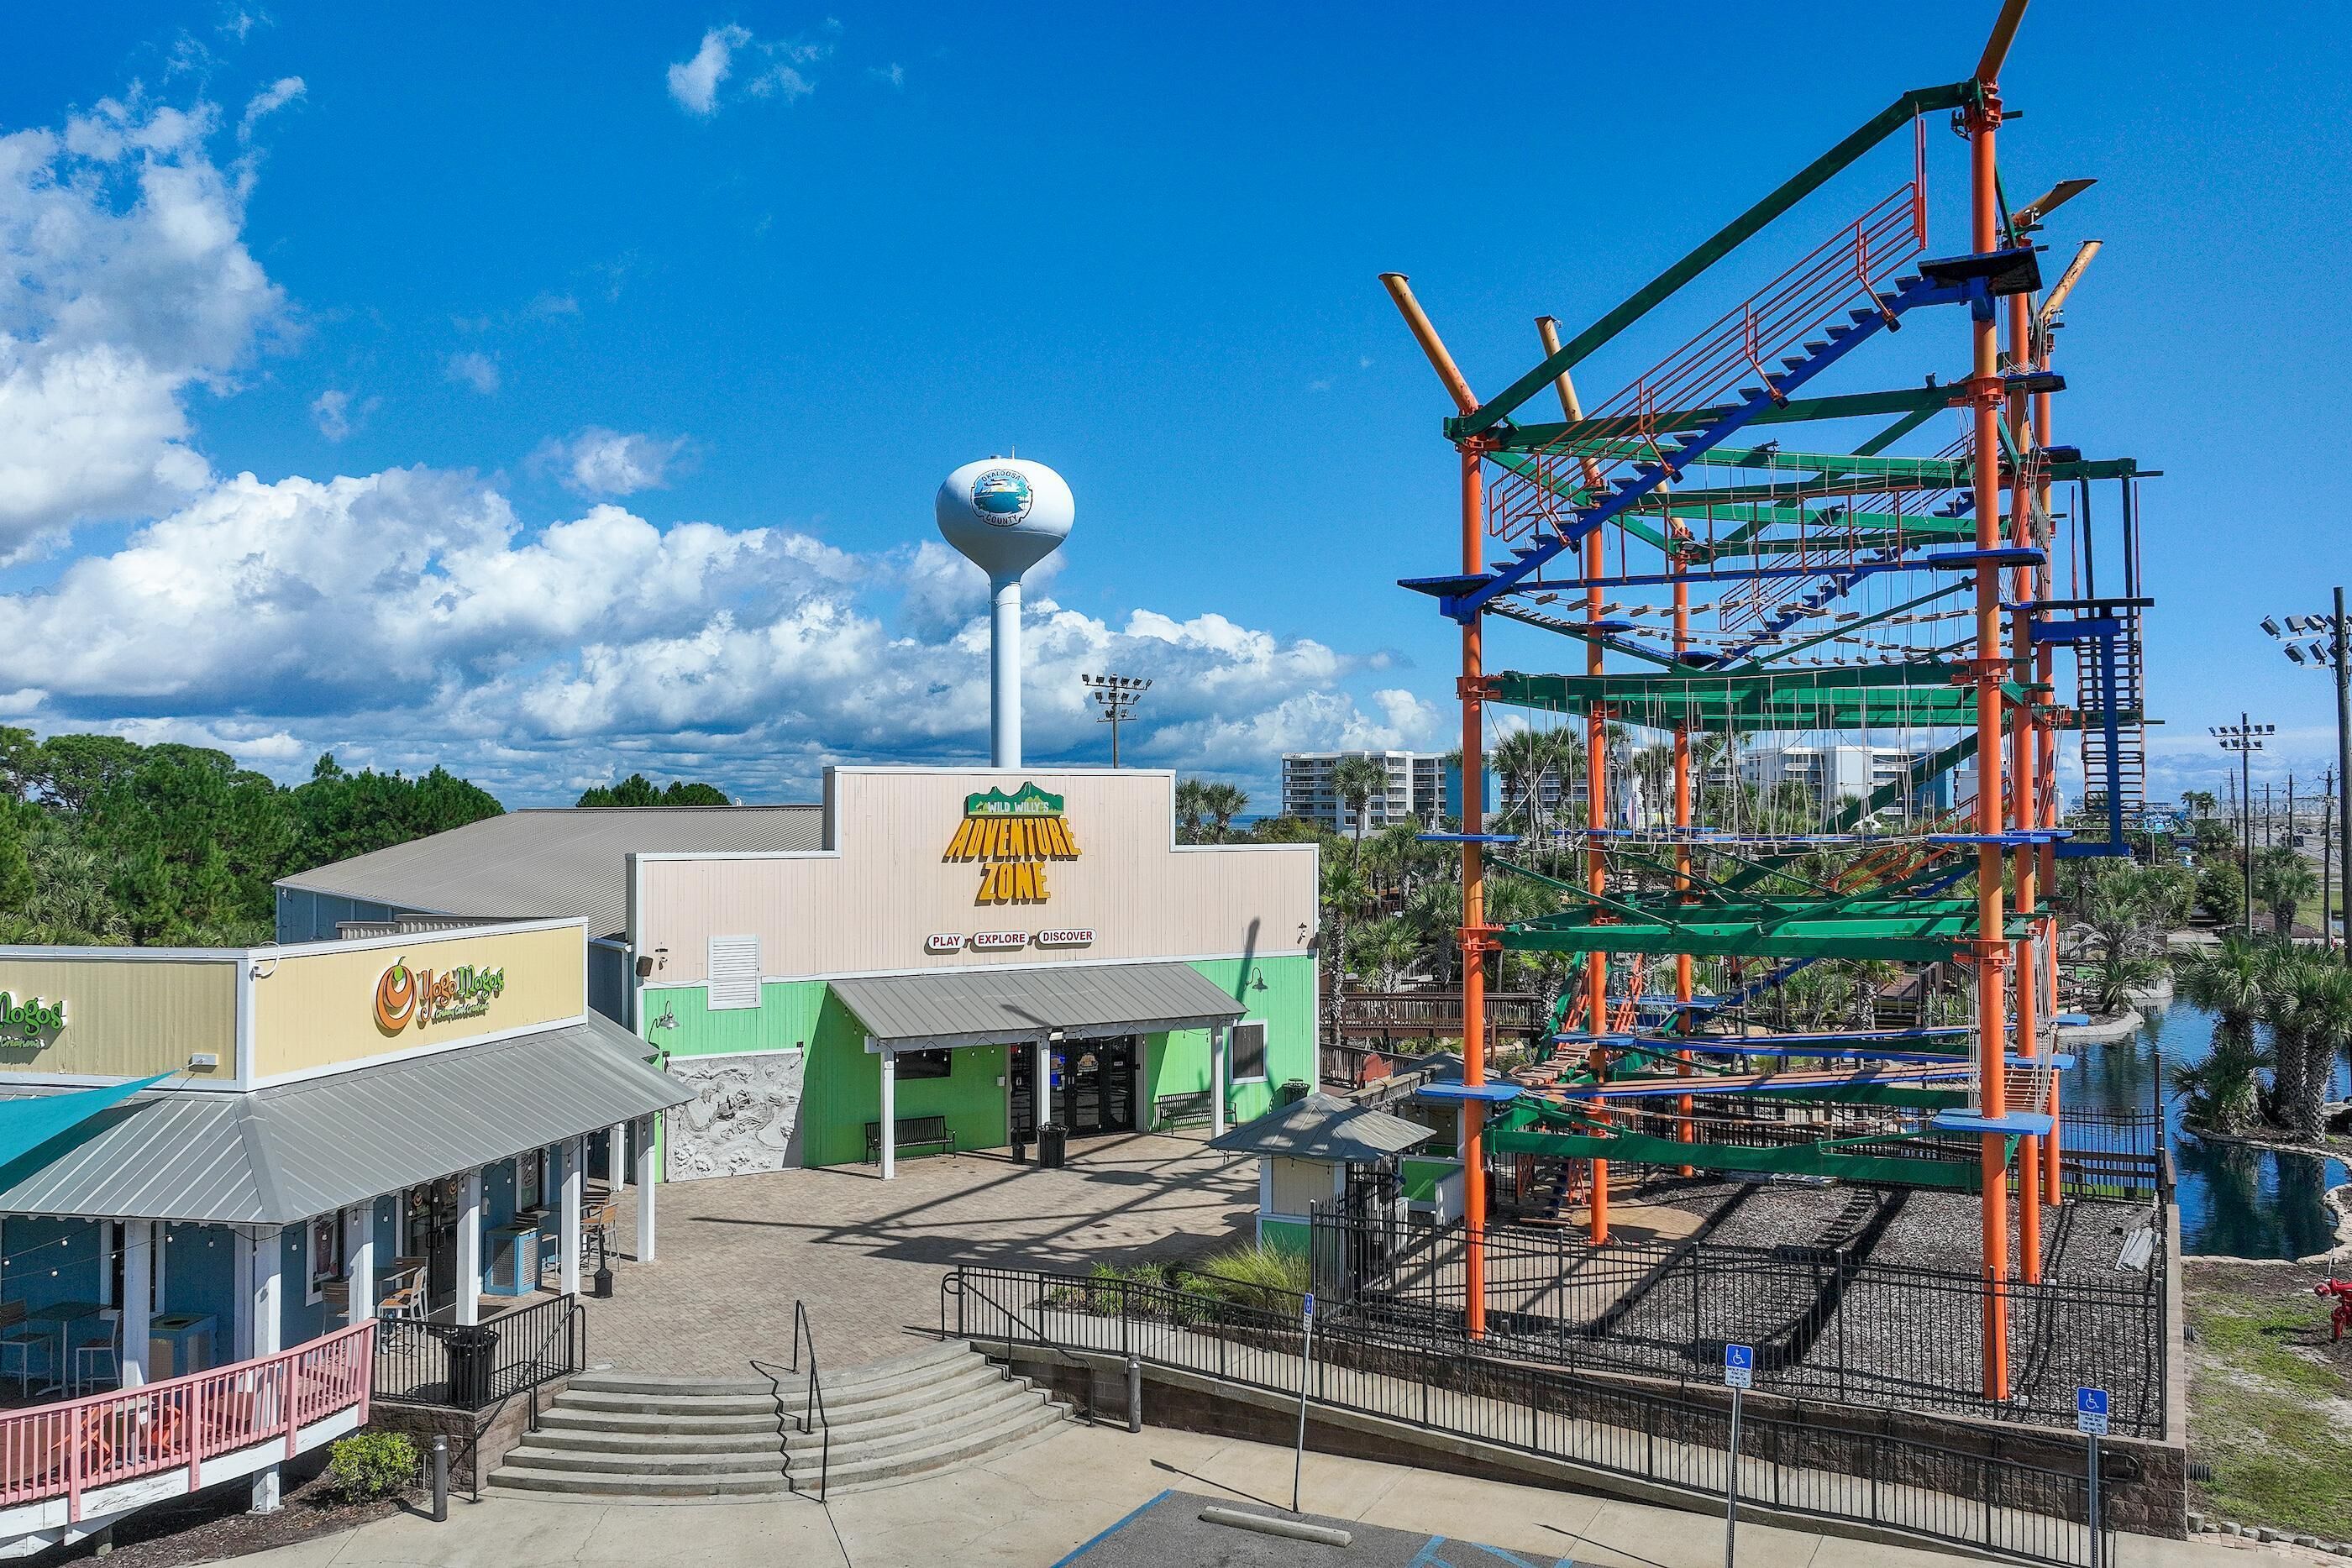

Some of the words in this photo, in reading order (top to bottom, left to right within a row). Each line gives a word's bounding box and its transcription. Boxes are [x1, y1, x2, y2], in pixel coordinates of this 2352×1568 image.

[981, 470, 1021, 482] OKALOOSA
[985, 514, 1017, 525] COUNTY
[987, 801, 1011, 813] WILD
[1014, 801, 1049, 813] WILLY'S
[944, 817, 1082, 857] ADVENTURE
[979, 862, 1051, 900] ZONE
[933, 936, 961, 947] PLAY
[978, 933, 1026, 944] EXPLORE
[1042, 931, 1093, 941] DISCOVER
[420, 968, 457, 1022] Yogo
[457, 964, 505, 1000] Mogos
